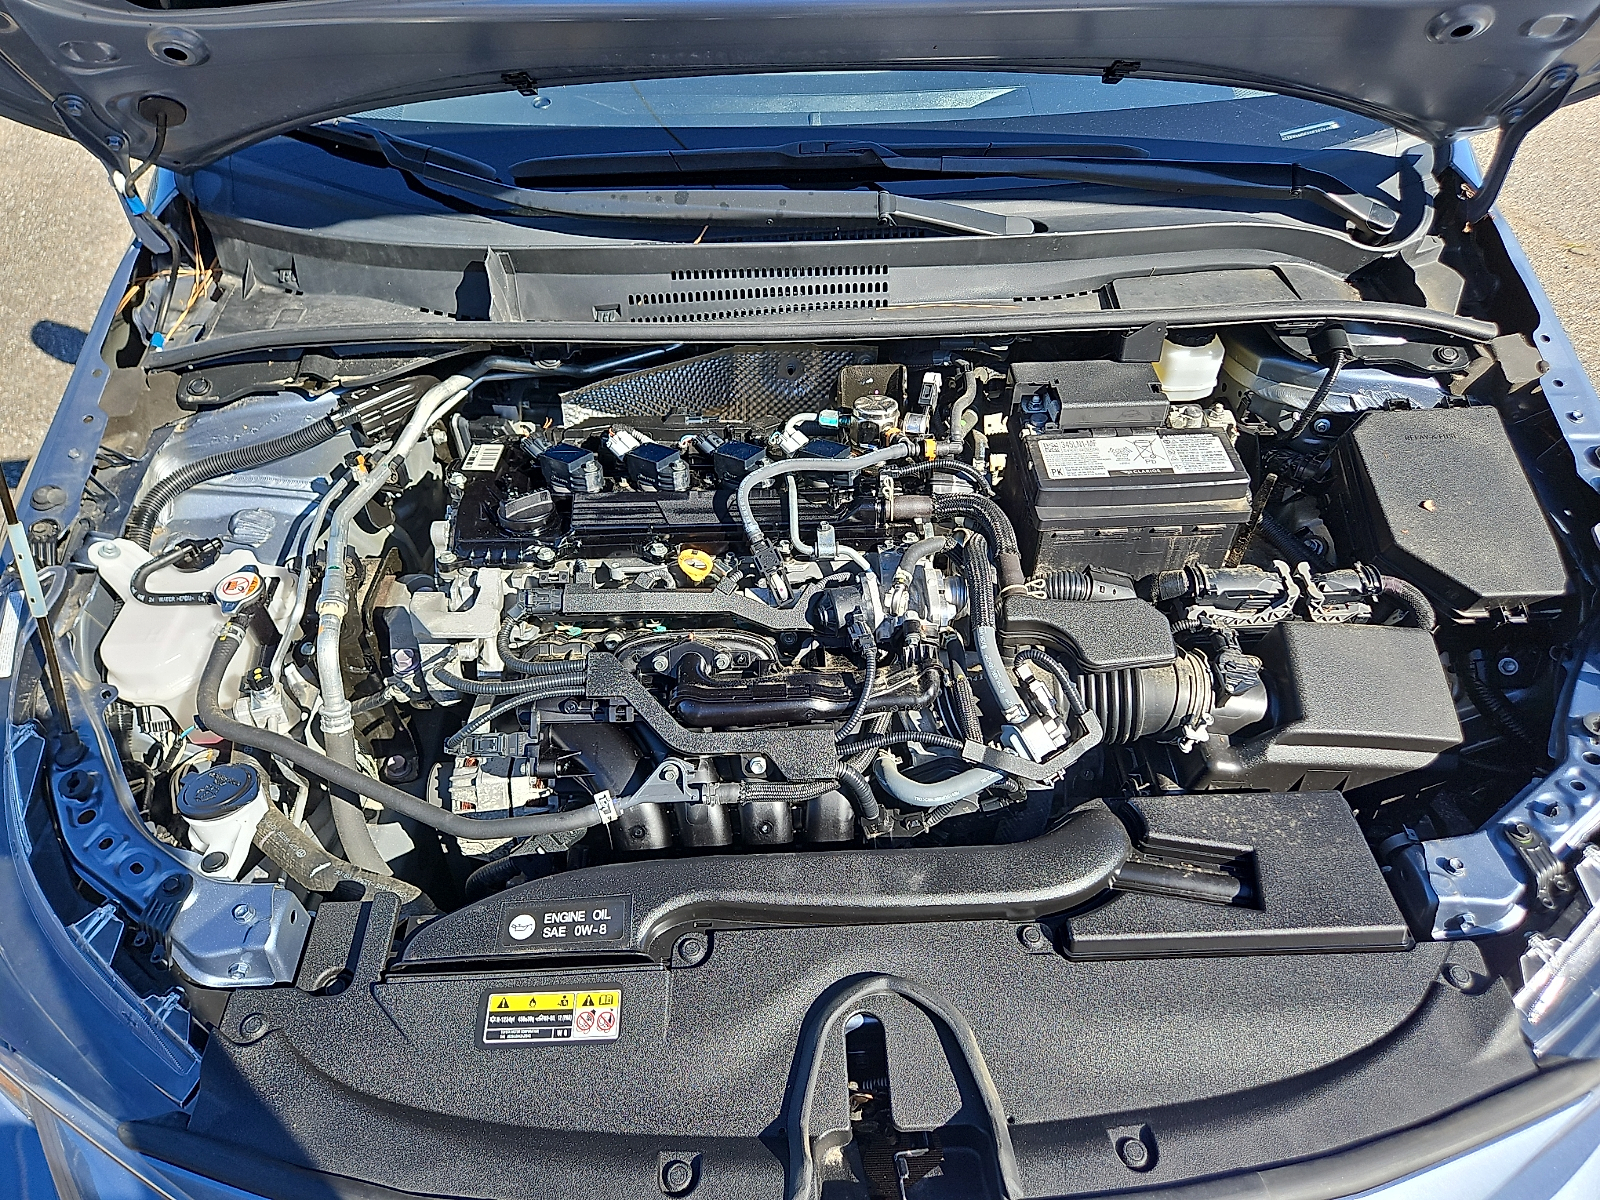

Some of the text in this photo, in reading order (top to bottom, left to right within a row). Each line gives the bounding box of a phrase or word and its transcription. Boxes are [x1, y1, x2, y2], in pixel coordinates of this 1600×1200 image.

[1050, 468, 1064, 476] PK
[543, 908, 612, 924] ENGINE OIL
[542, 923, 607, 939] SAE 0W-8
